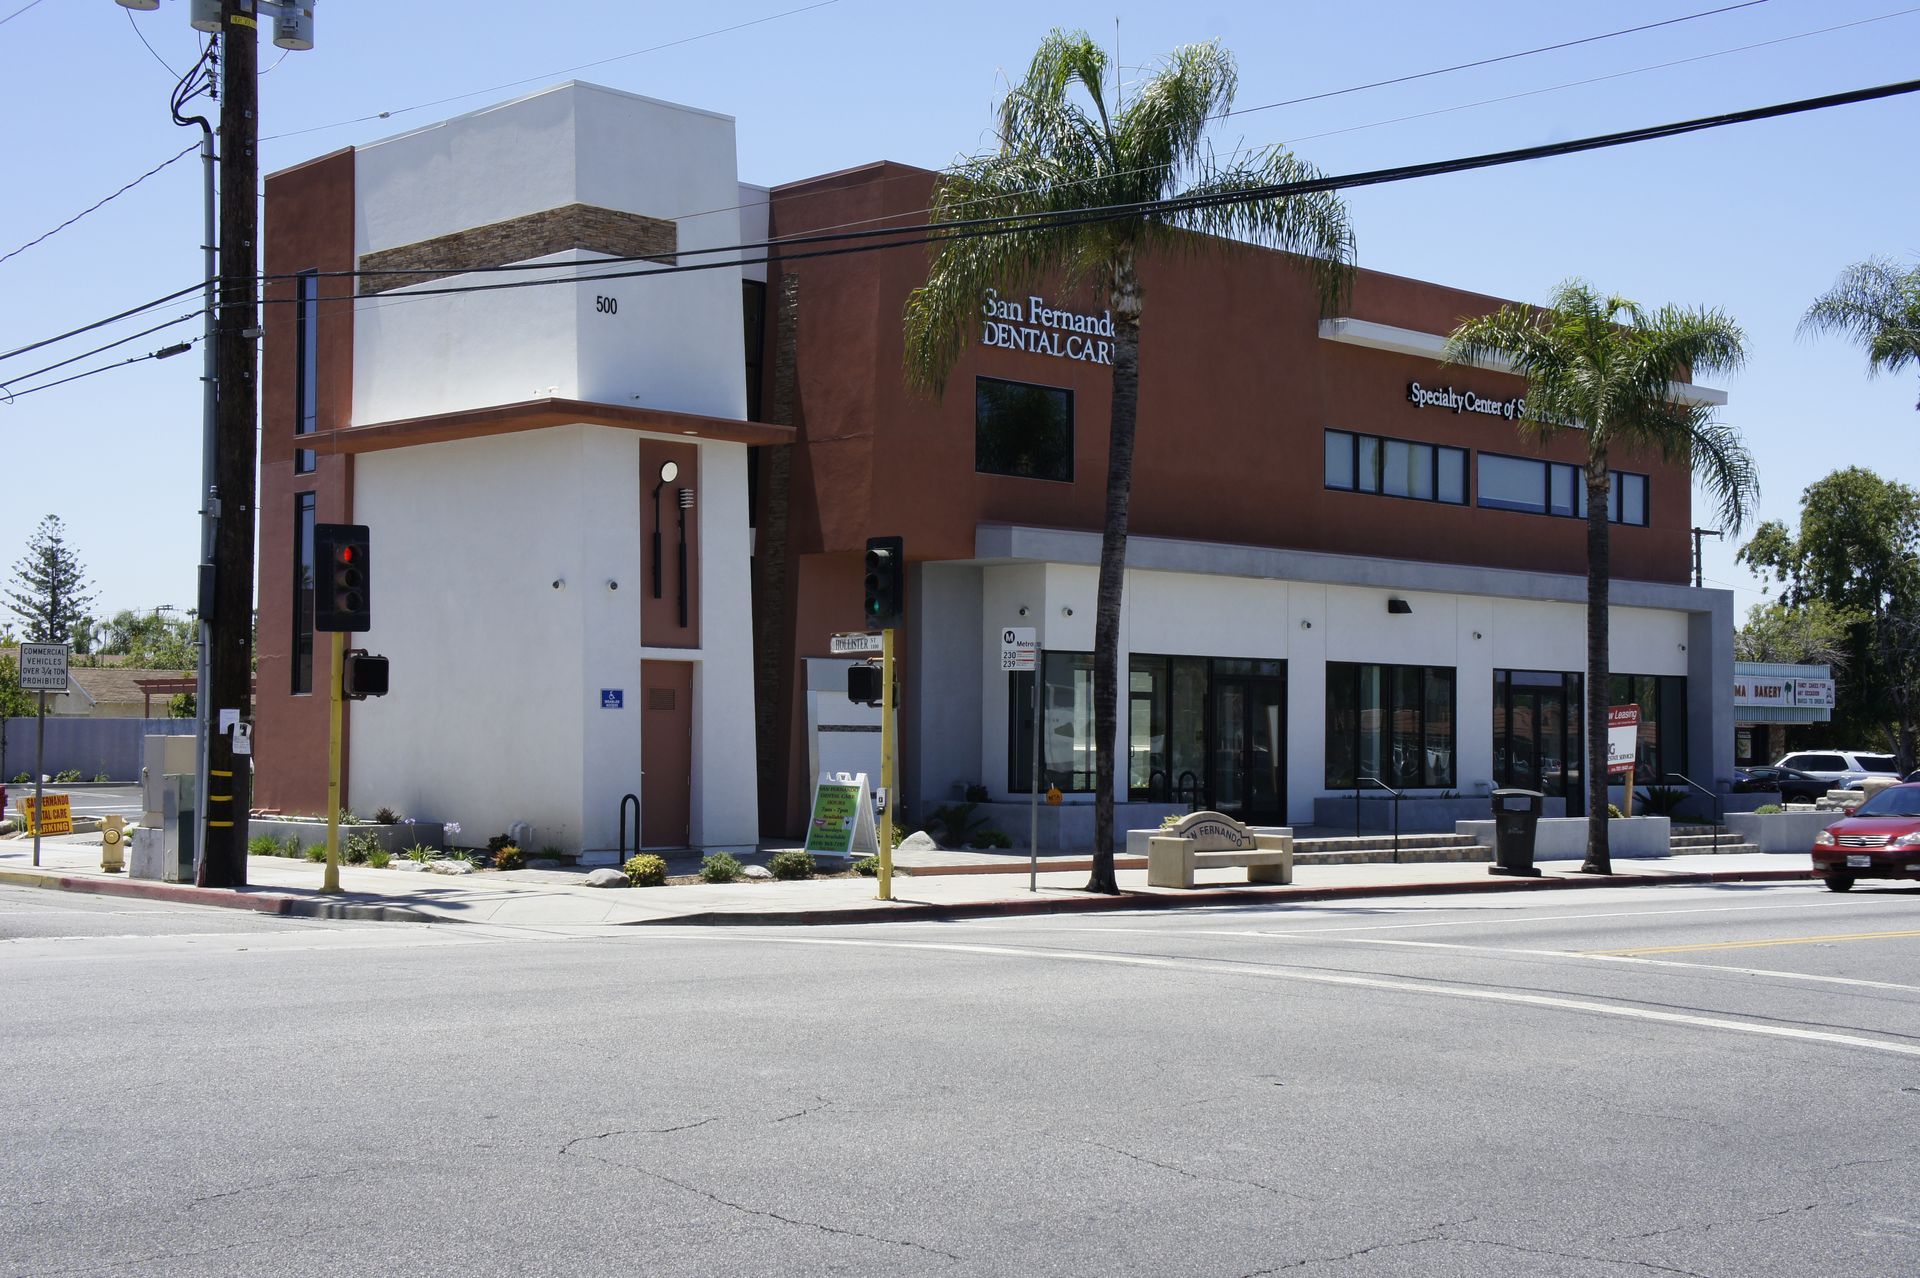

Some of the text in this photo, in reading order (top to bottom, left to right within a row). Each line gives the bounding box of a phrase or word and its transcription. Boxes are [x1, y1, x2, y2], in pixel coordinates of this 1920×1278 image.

[596, 295, 617, 314] 500
[983, 288, 1023, 321] San
[983, 321, 1064, 357] DENTAL
[1411, 382, 1464, 413] Specialty
[1464, 391, 1502, 415] Center
[1503, 398, 1516, 420] of
[835, 638, 869, 650] HOLLISTER
[23, 648, 65, 656] COMMERCIAL
[1003, 651, 1017, 659] 230
[27, 657, 62, 665] VEHICLES
[1003, 660, 1016, 668] 239
[22, 667, 40, 675] OVER
[41, 666, 52, 675] 3/4
[22, 677, 66, 685] PROHIBITED
[1754, 685, 1781, 698] BAKERY
[1614, 708, 1637, 720] Leasing
[42, 795, 69, 807] ERNANDO
[53, 808, 67, 819] CARE
[1200, 826, 1242, 847] FERNANDO
